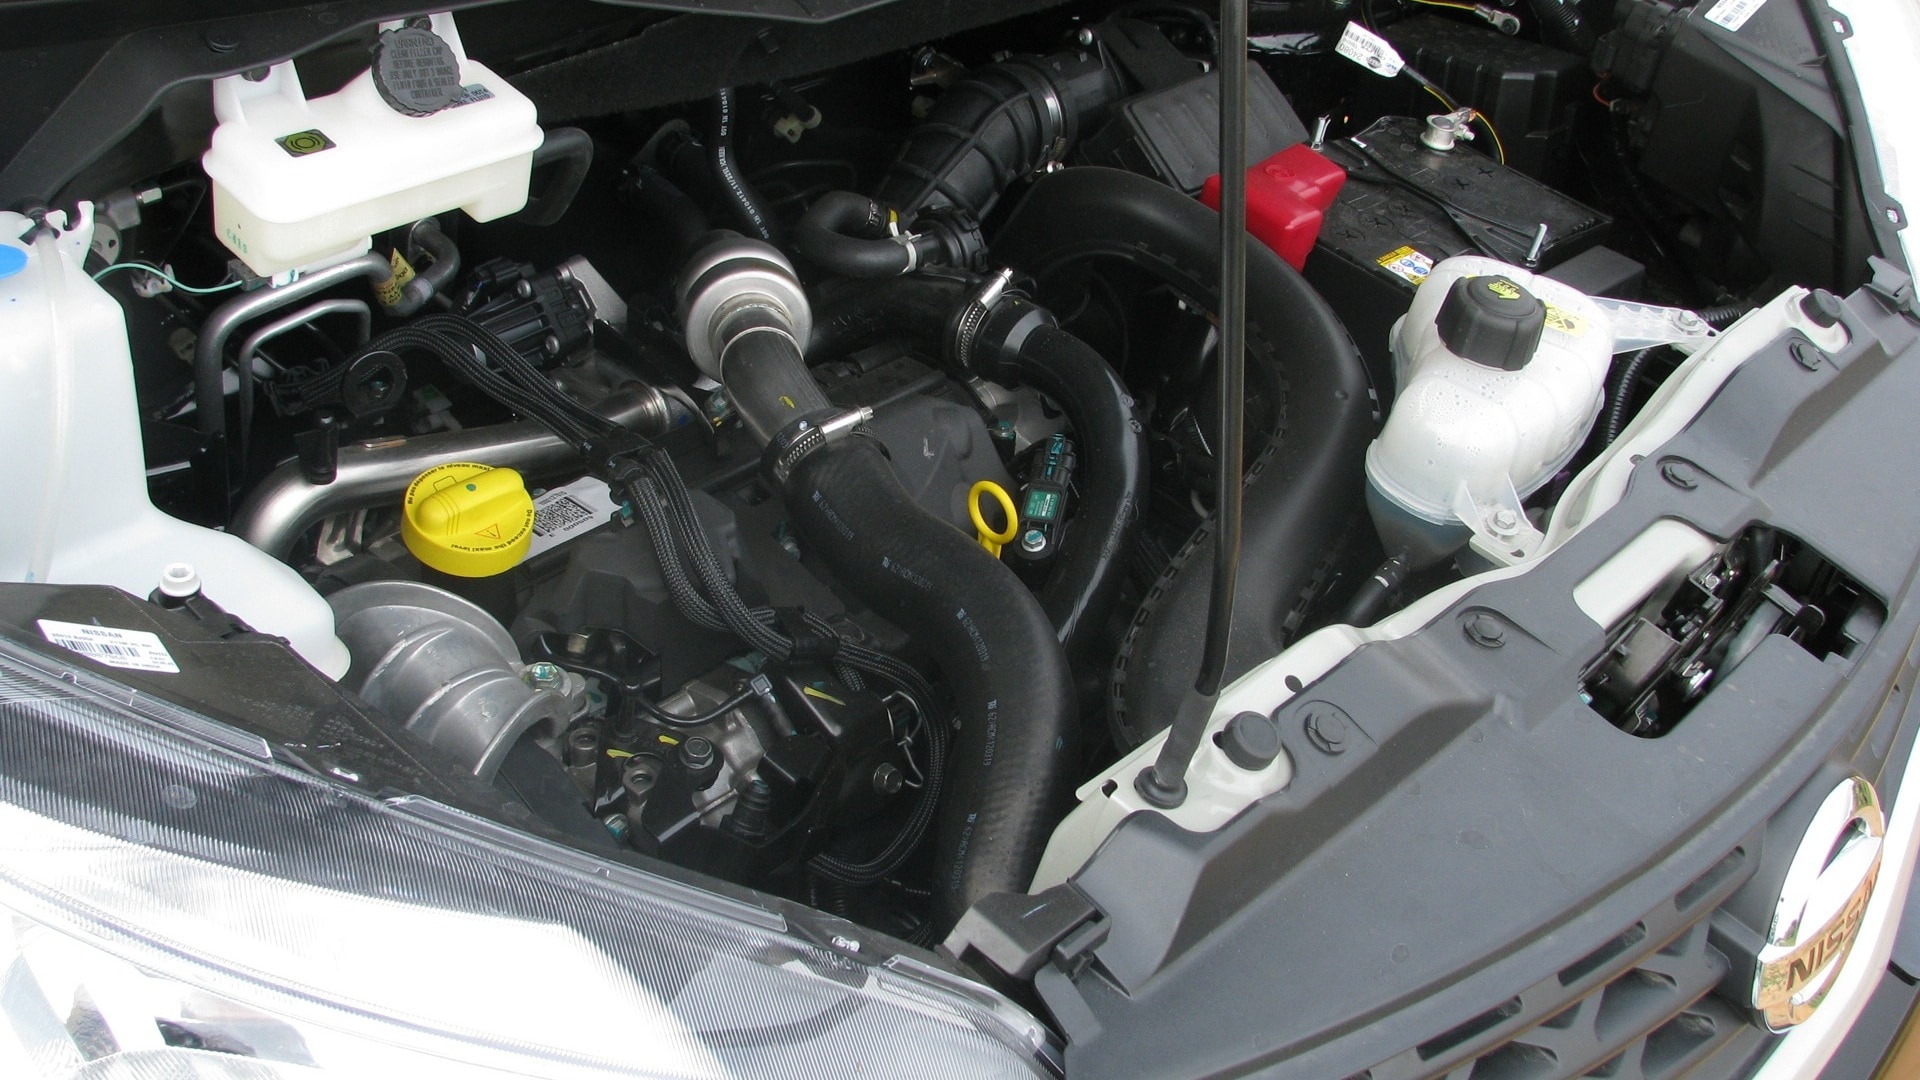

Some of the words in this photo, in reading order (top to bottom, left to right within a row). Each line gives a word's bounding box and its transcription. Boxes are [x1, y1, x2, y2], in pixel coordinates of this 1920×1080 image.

[409, 486, 417, 497] pas
[471, 463, 491, 472] maxi
[523, 518, 531, 528] not
[506, 527, 527, 546] exceed
[81, 628, 123, 638] NISSAN
[1785, 874, 1876, 992] NISSA
